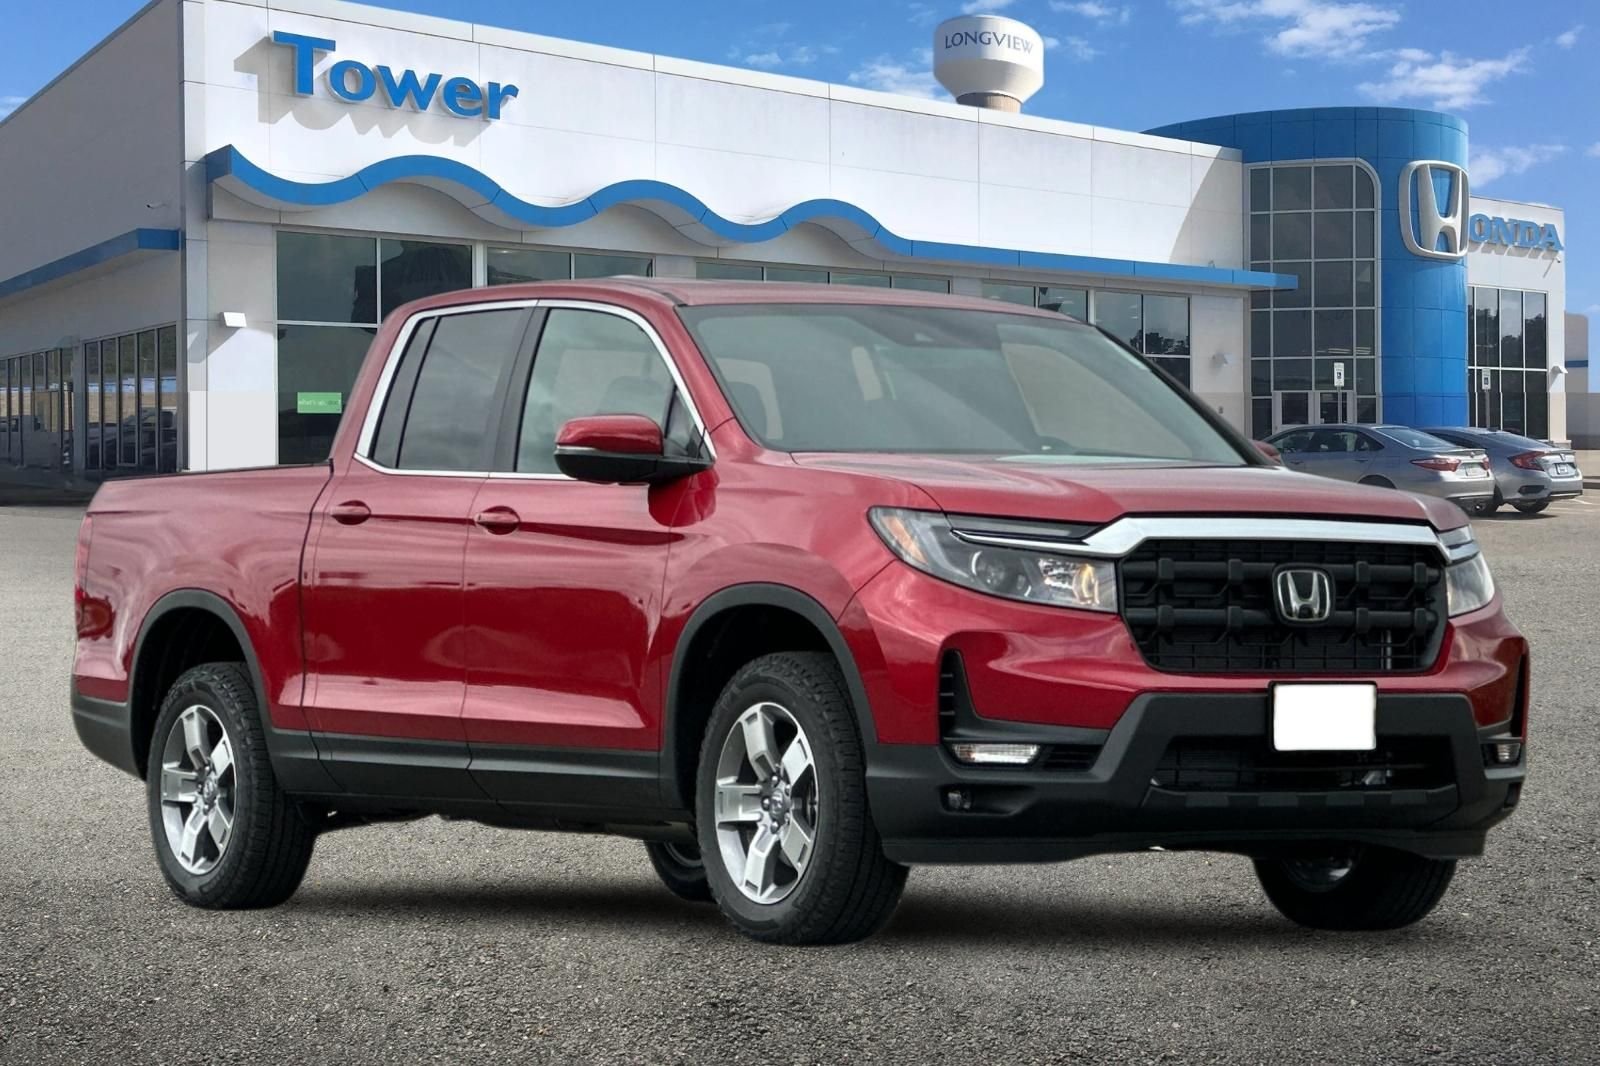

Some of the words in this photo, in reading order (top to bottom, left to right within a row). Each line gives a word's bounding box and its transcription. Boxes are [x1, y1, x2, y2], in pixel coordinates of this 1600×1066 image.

[945, 31, 1034, 54] LONGVIEW
[273, 30, 519, 120] Tower
[1468, 213, 1564, 251] ONDA
